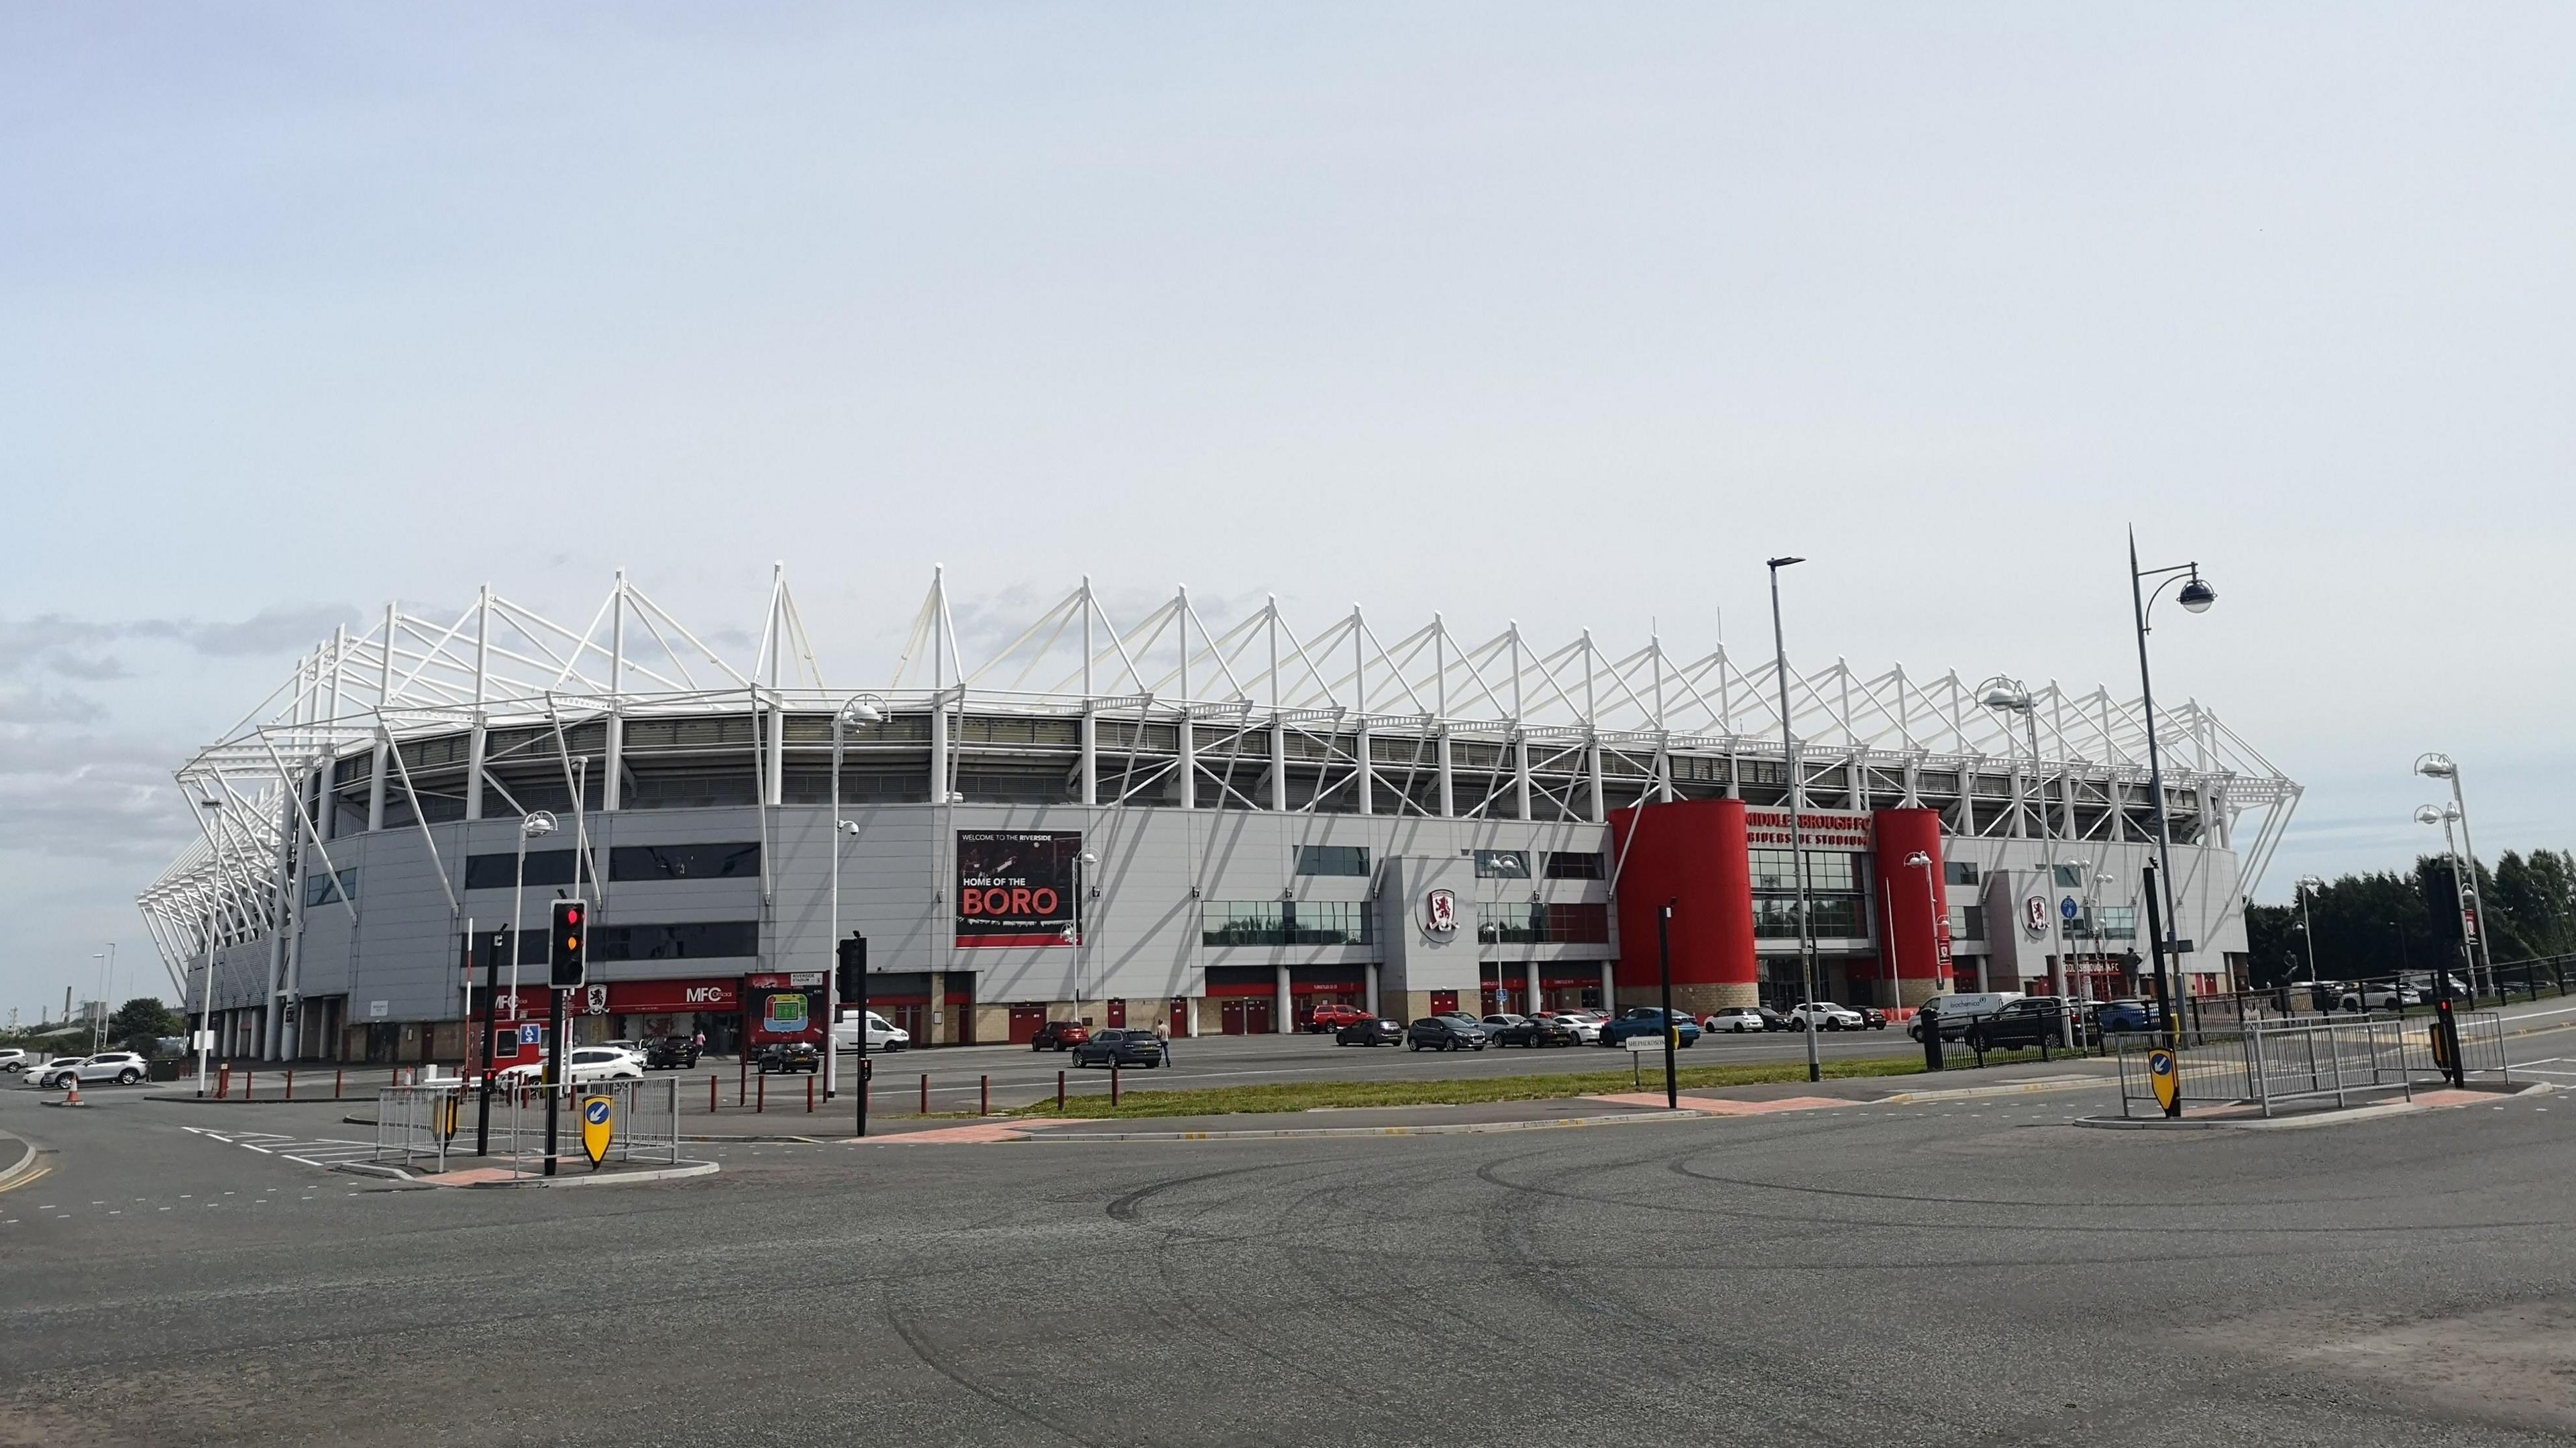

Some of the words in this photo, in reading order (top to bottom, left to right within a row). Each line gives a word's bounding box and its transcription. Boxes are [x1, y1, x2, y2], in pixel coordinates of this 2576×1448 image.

[1747, 832, 1813, 844] RIVERSDE
[963, 878, 991, 886] HOME
[993, 878, 1006, 886] OF
[1008, 878, 1026, 886] THE
[963, 888, 1058, 915] BORO
[686, 987, 722, 1002] MFC
